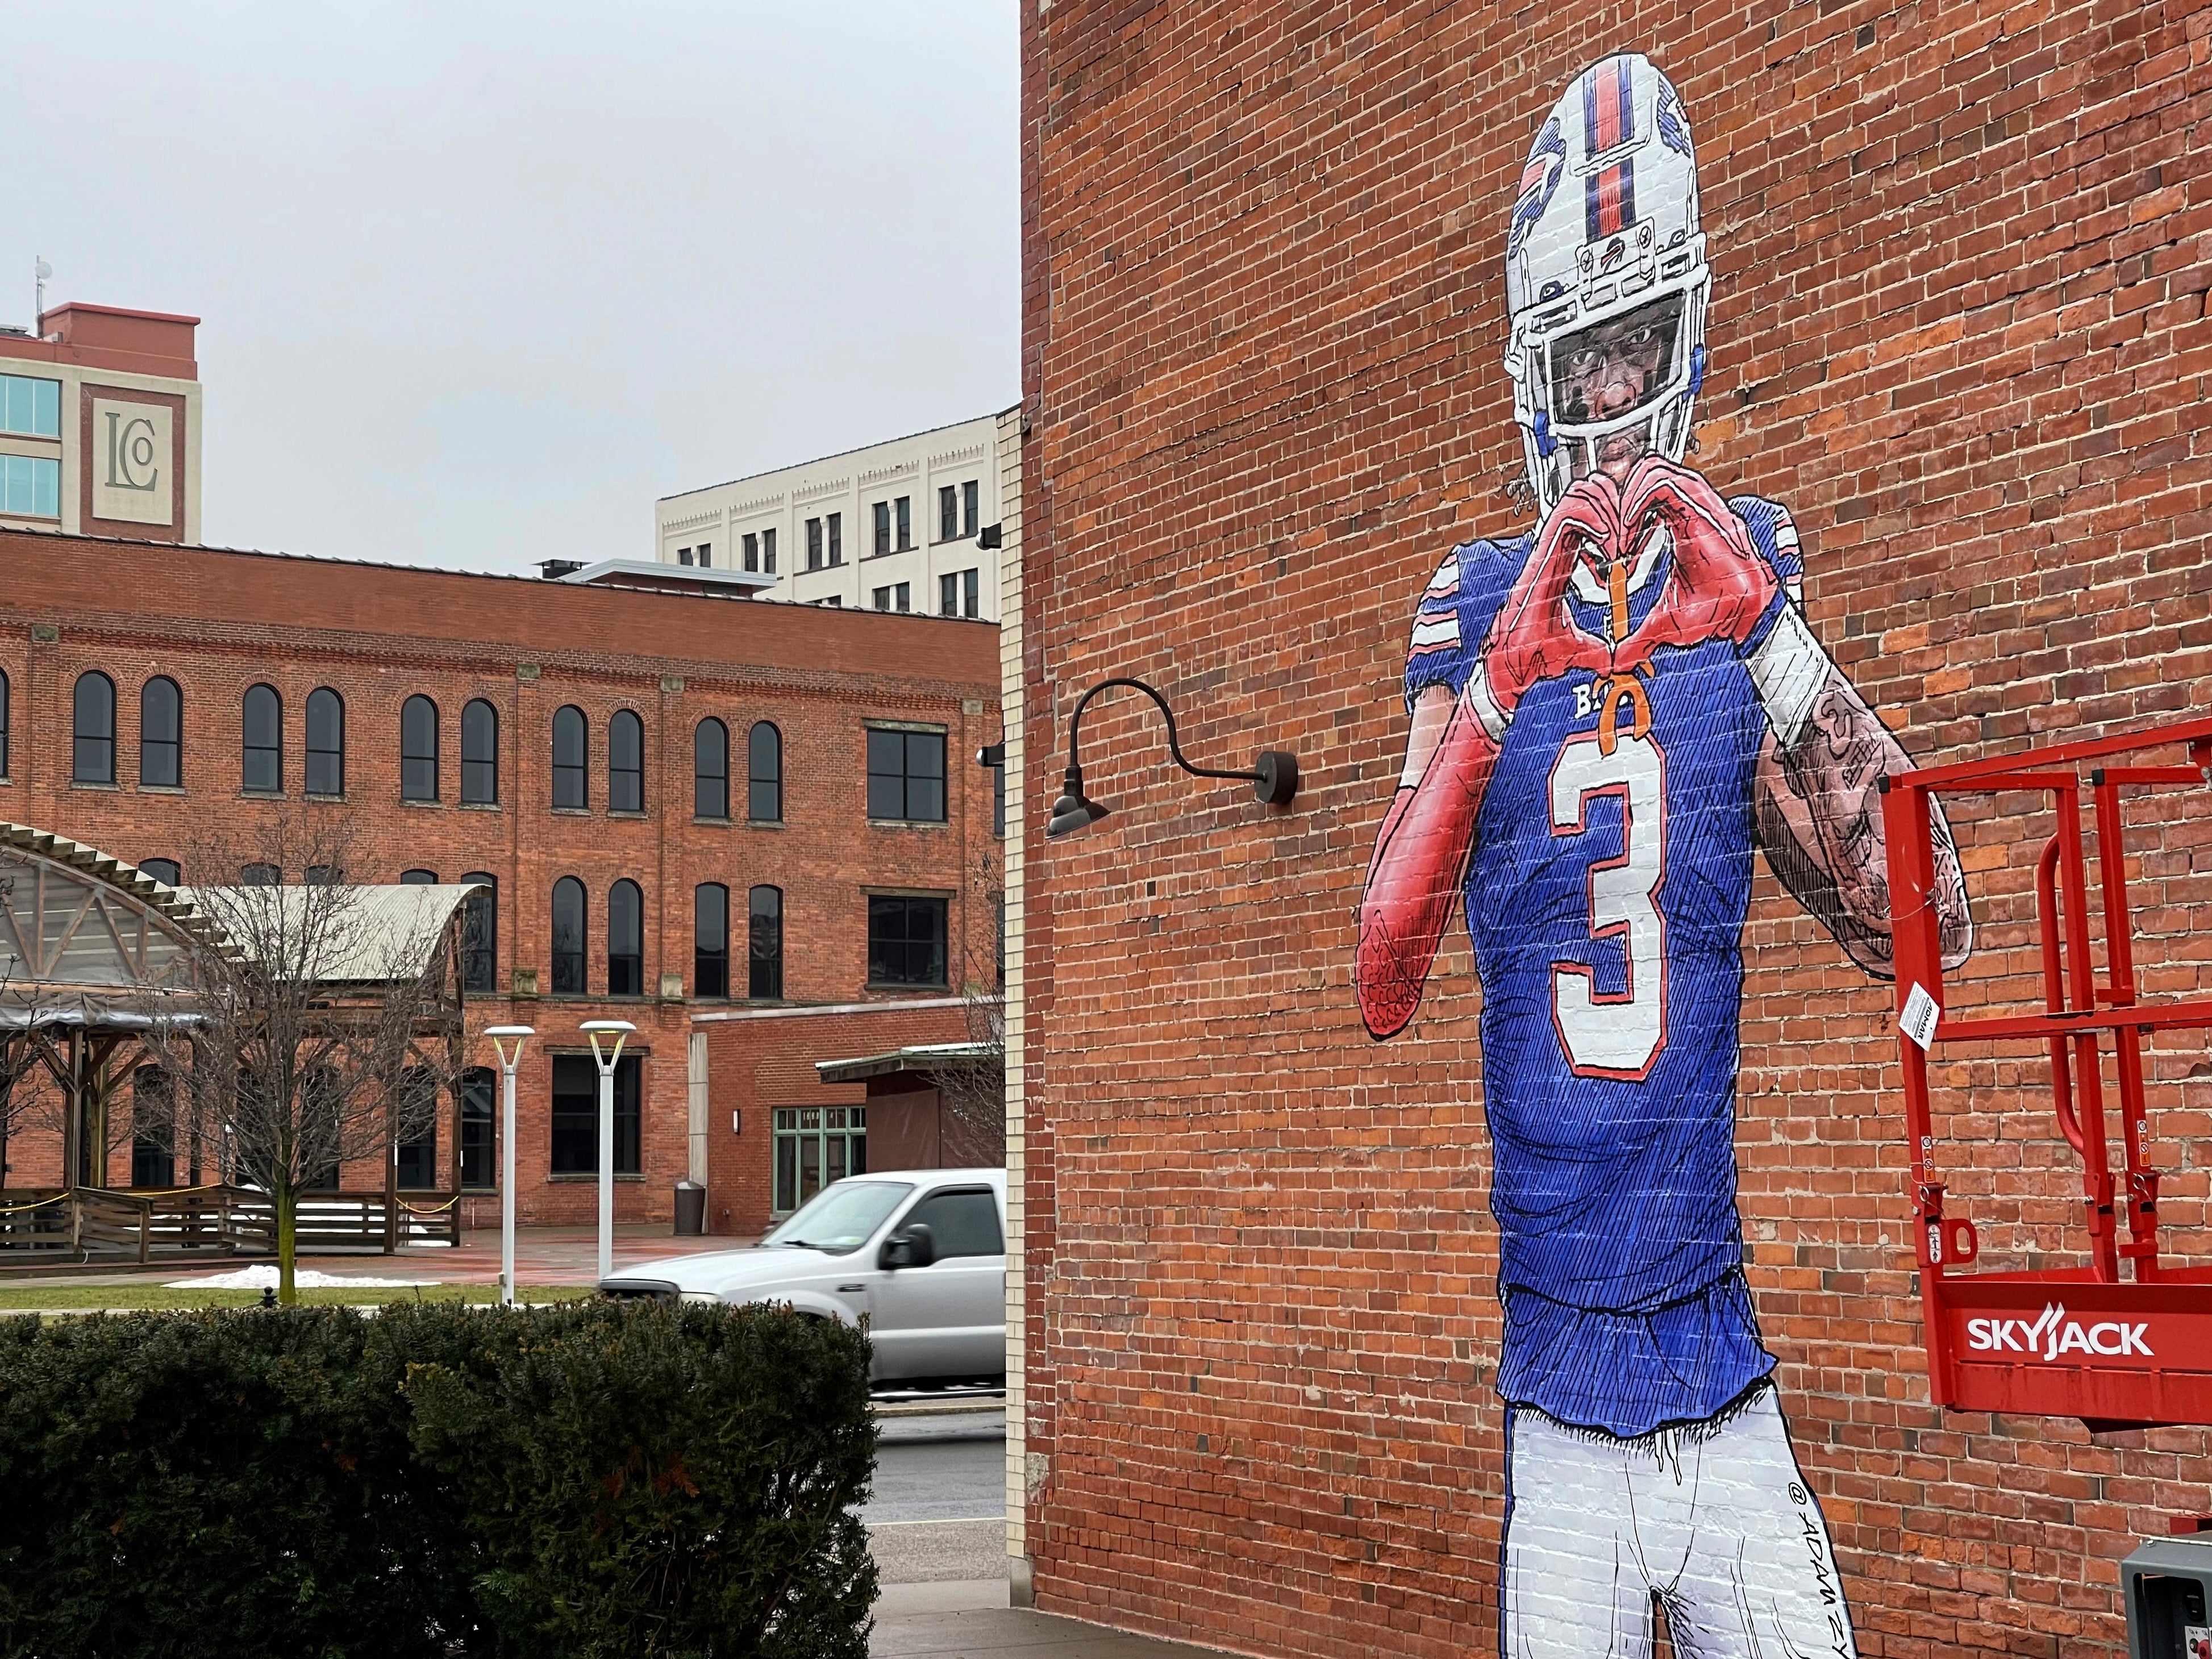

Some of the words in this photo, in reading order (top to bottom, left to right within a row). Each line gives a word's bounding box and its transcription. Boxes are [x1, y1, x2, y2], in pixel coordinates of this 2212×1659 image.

[1547, 726, 1668, 1085] 3
[1917, 1002, 1932, 1040] ADMAR
[1968, 1302, 2155, 1361] SKYJACK
